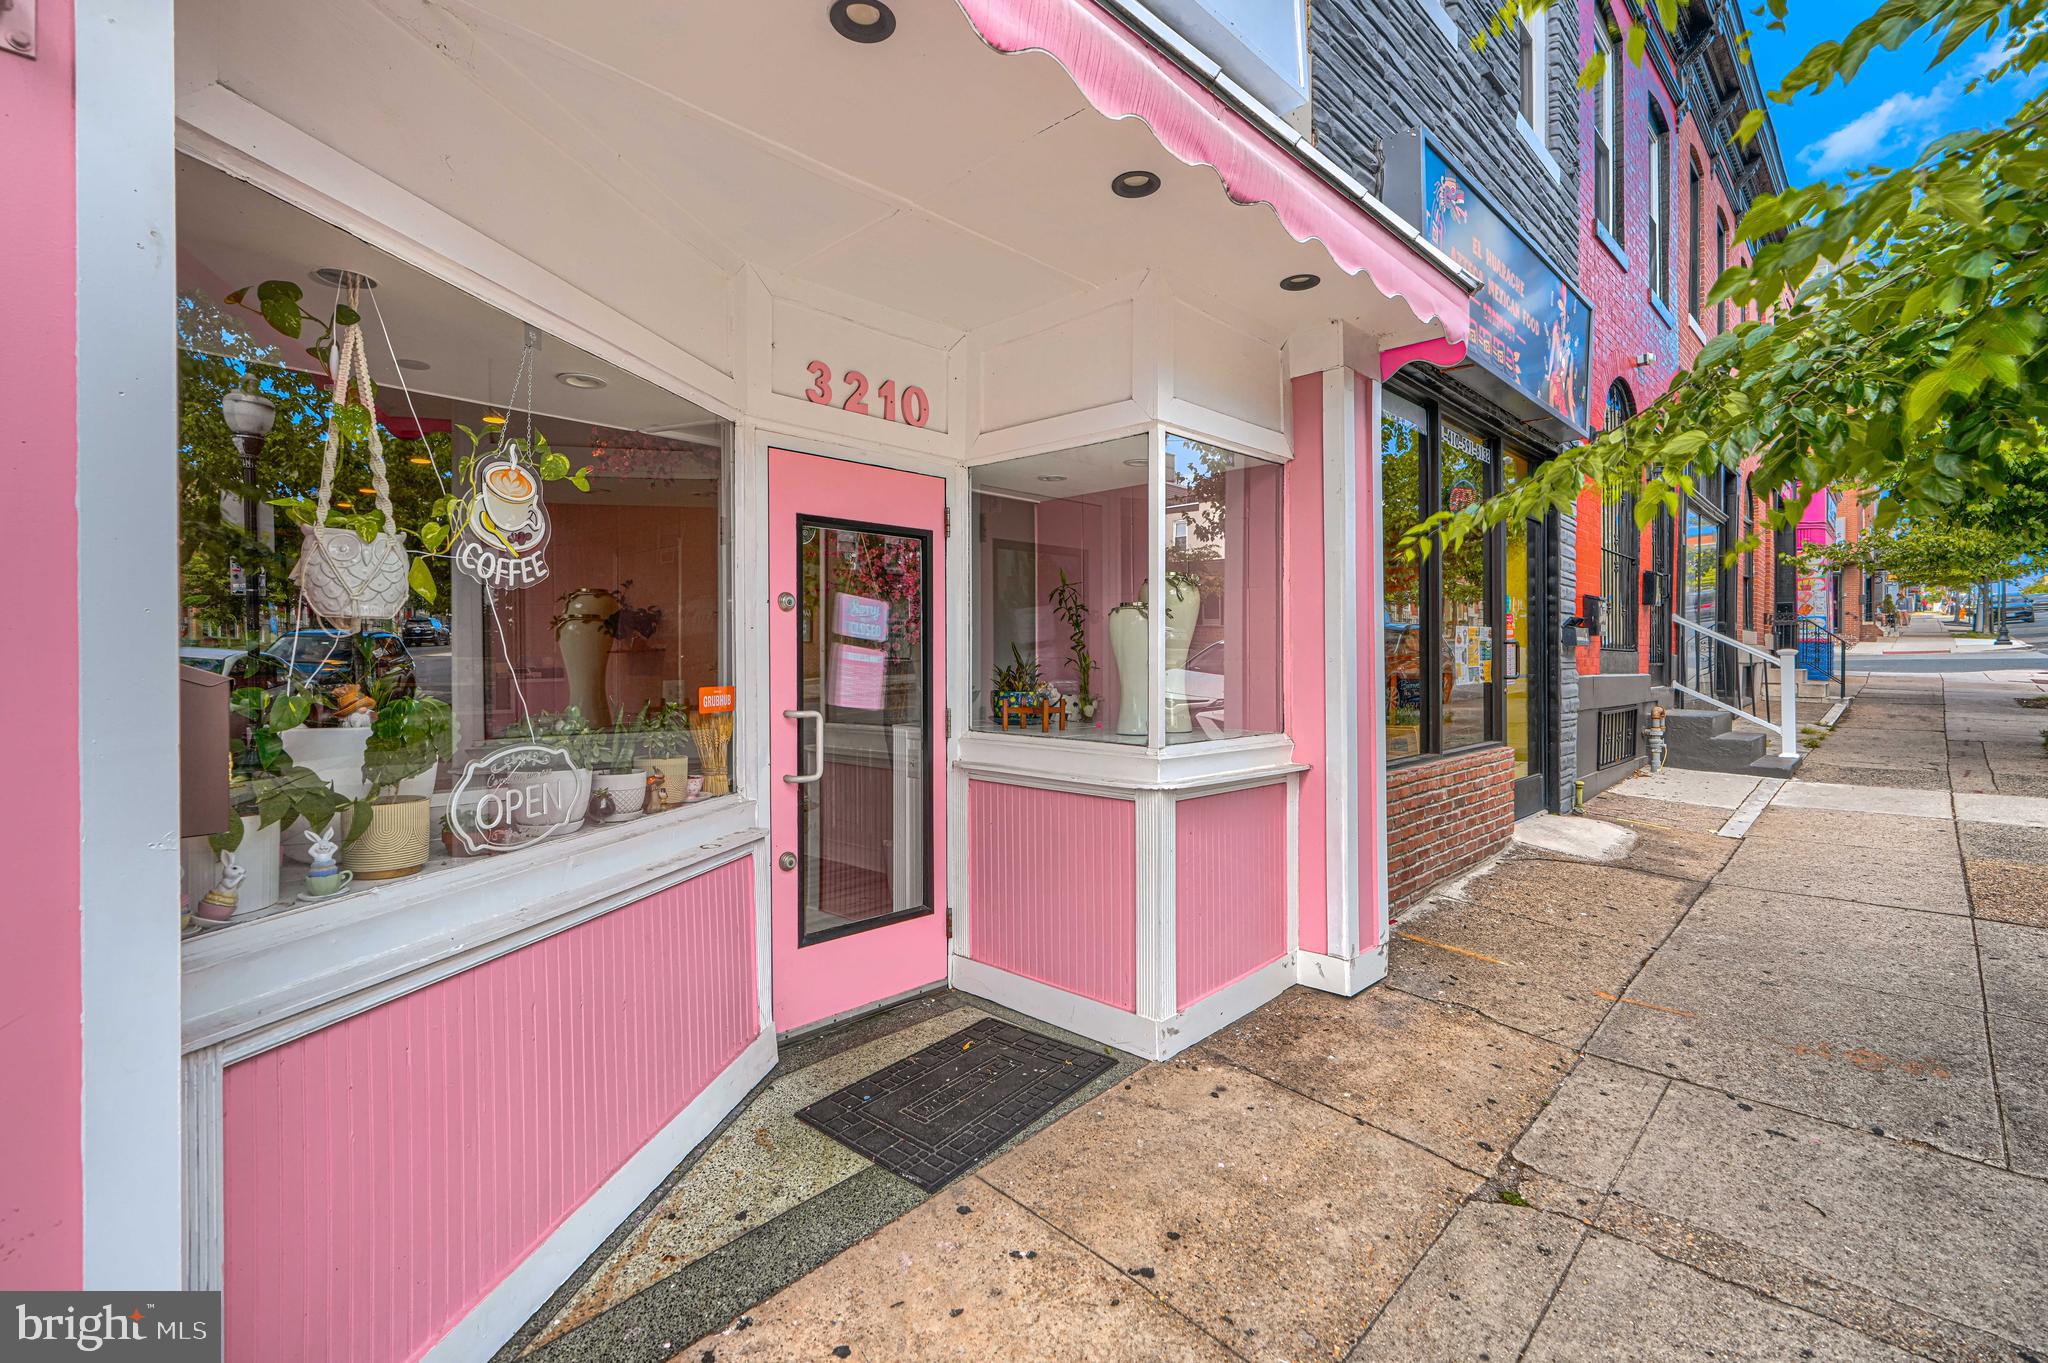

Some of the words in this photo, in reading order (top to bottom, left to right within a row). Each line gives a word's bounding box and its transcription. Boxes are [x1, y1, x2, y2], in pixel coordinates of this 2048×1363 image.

[1472, 236, 1482, 259] EL
[1488, 279, 1520, 319] MEXICAN
[1522, 309, 1540, 337] FOOD
[805, 360, 930, 428] 3210
[462, 543, 548, 587] COFFEE
[703, 694, 732, 708] GRUBHUB
[477, 780, 562, 829] OPEN
